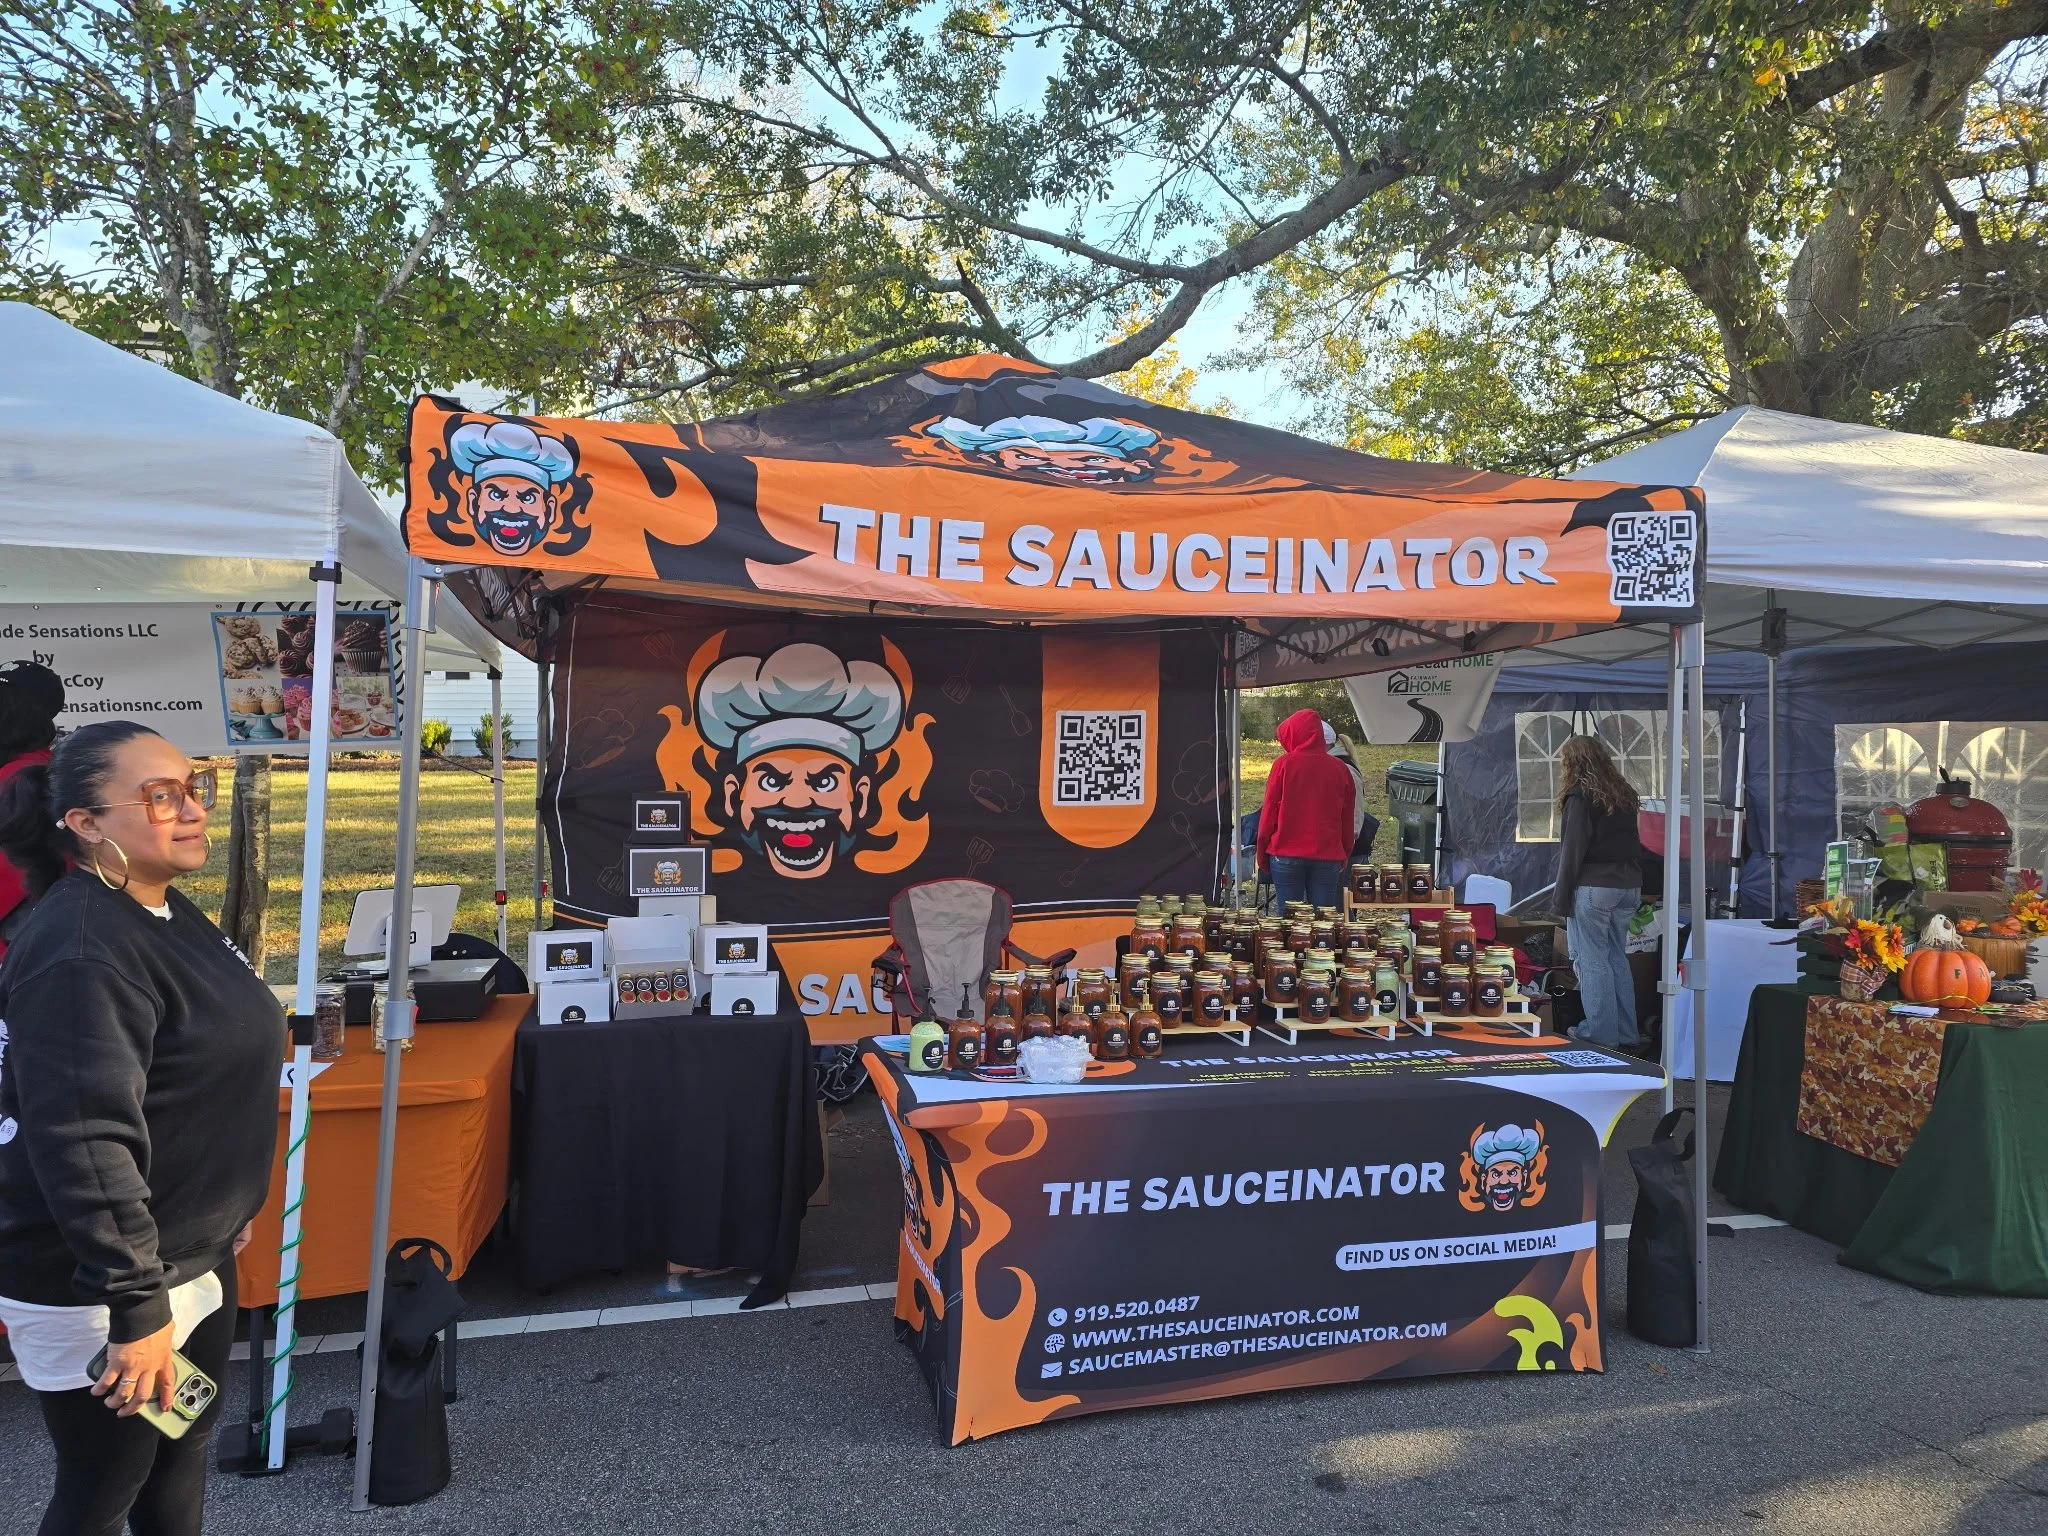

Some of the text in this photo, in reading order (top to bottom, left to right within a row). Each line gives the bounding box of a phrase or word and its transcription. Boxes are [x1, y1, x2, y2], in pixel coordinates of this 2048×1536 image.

[819, 503, 1559, 594] THE SAUCEINATOR
[29, 624, 124, 638] Sensations
[128, 623, 159, 637] LLC
[33, 650, 54, 667] by
[1453, 654, 1494, 668] HOME
[63, 674, 104, 690] cCoy
[1410, 680, 1452, 692] HOME
[61, 698, 203, 714] ensationsnc.com
[799, 974, 893, 1015] SAU
[1160, 1049, 1461, 1067] THE SAUCEINATOR
[1042, 1161, 1445, 1216] THE SAUCEINATOR
[1345, 1235, 1557, 1265] FIND US ON SOCIAL MEDIA!
[1074, 1296, 1200, 1323] 919.520.0487
[1072, 1306, 1360, 1349] WWW.THESAUCEINATOR.COM
[1068, 1322, 1448, 1375] SAUCEMASTER@THESAUCEINATOR.COM
